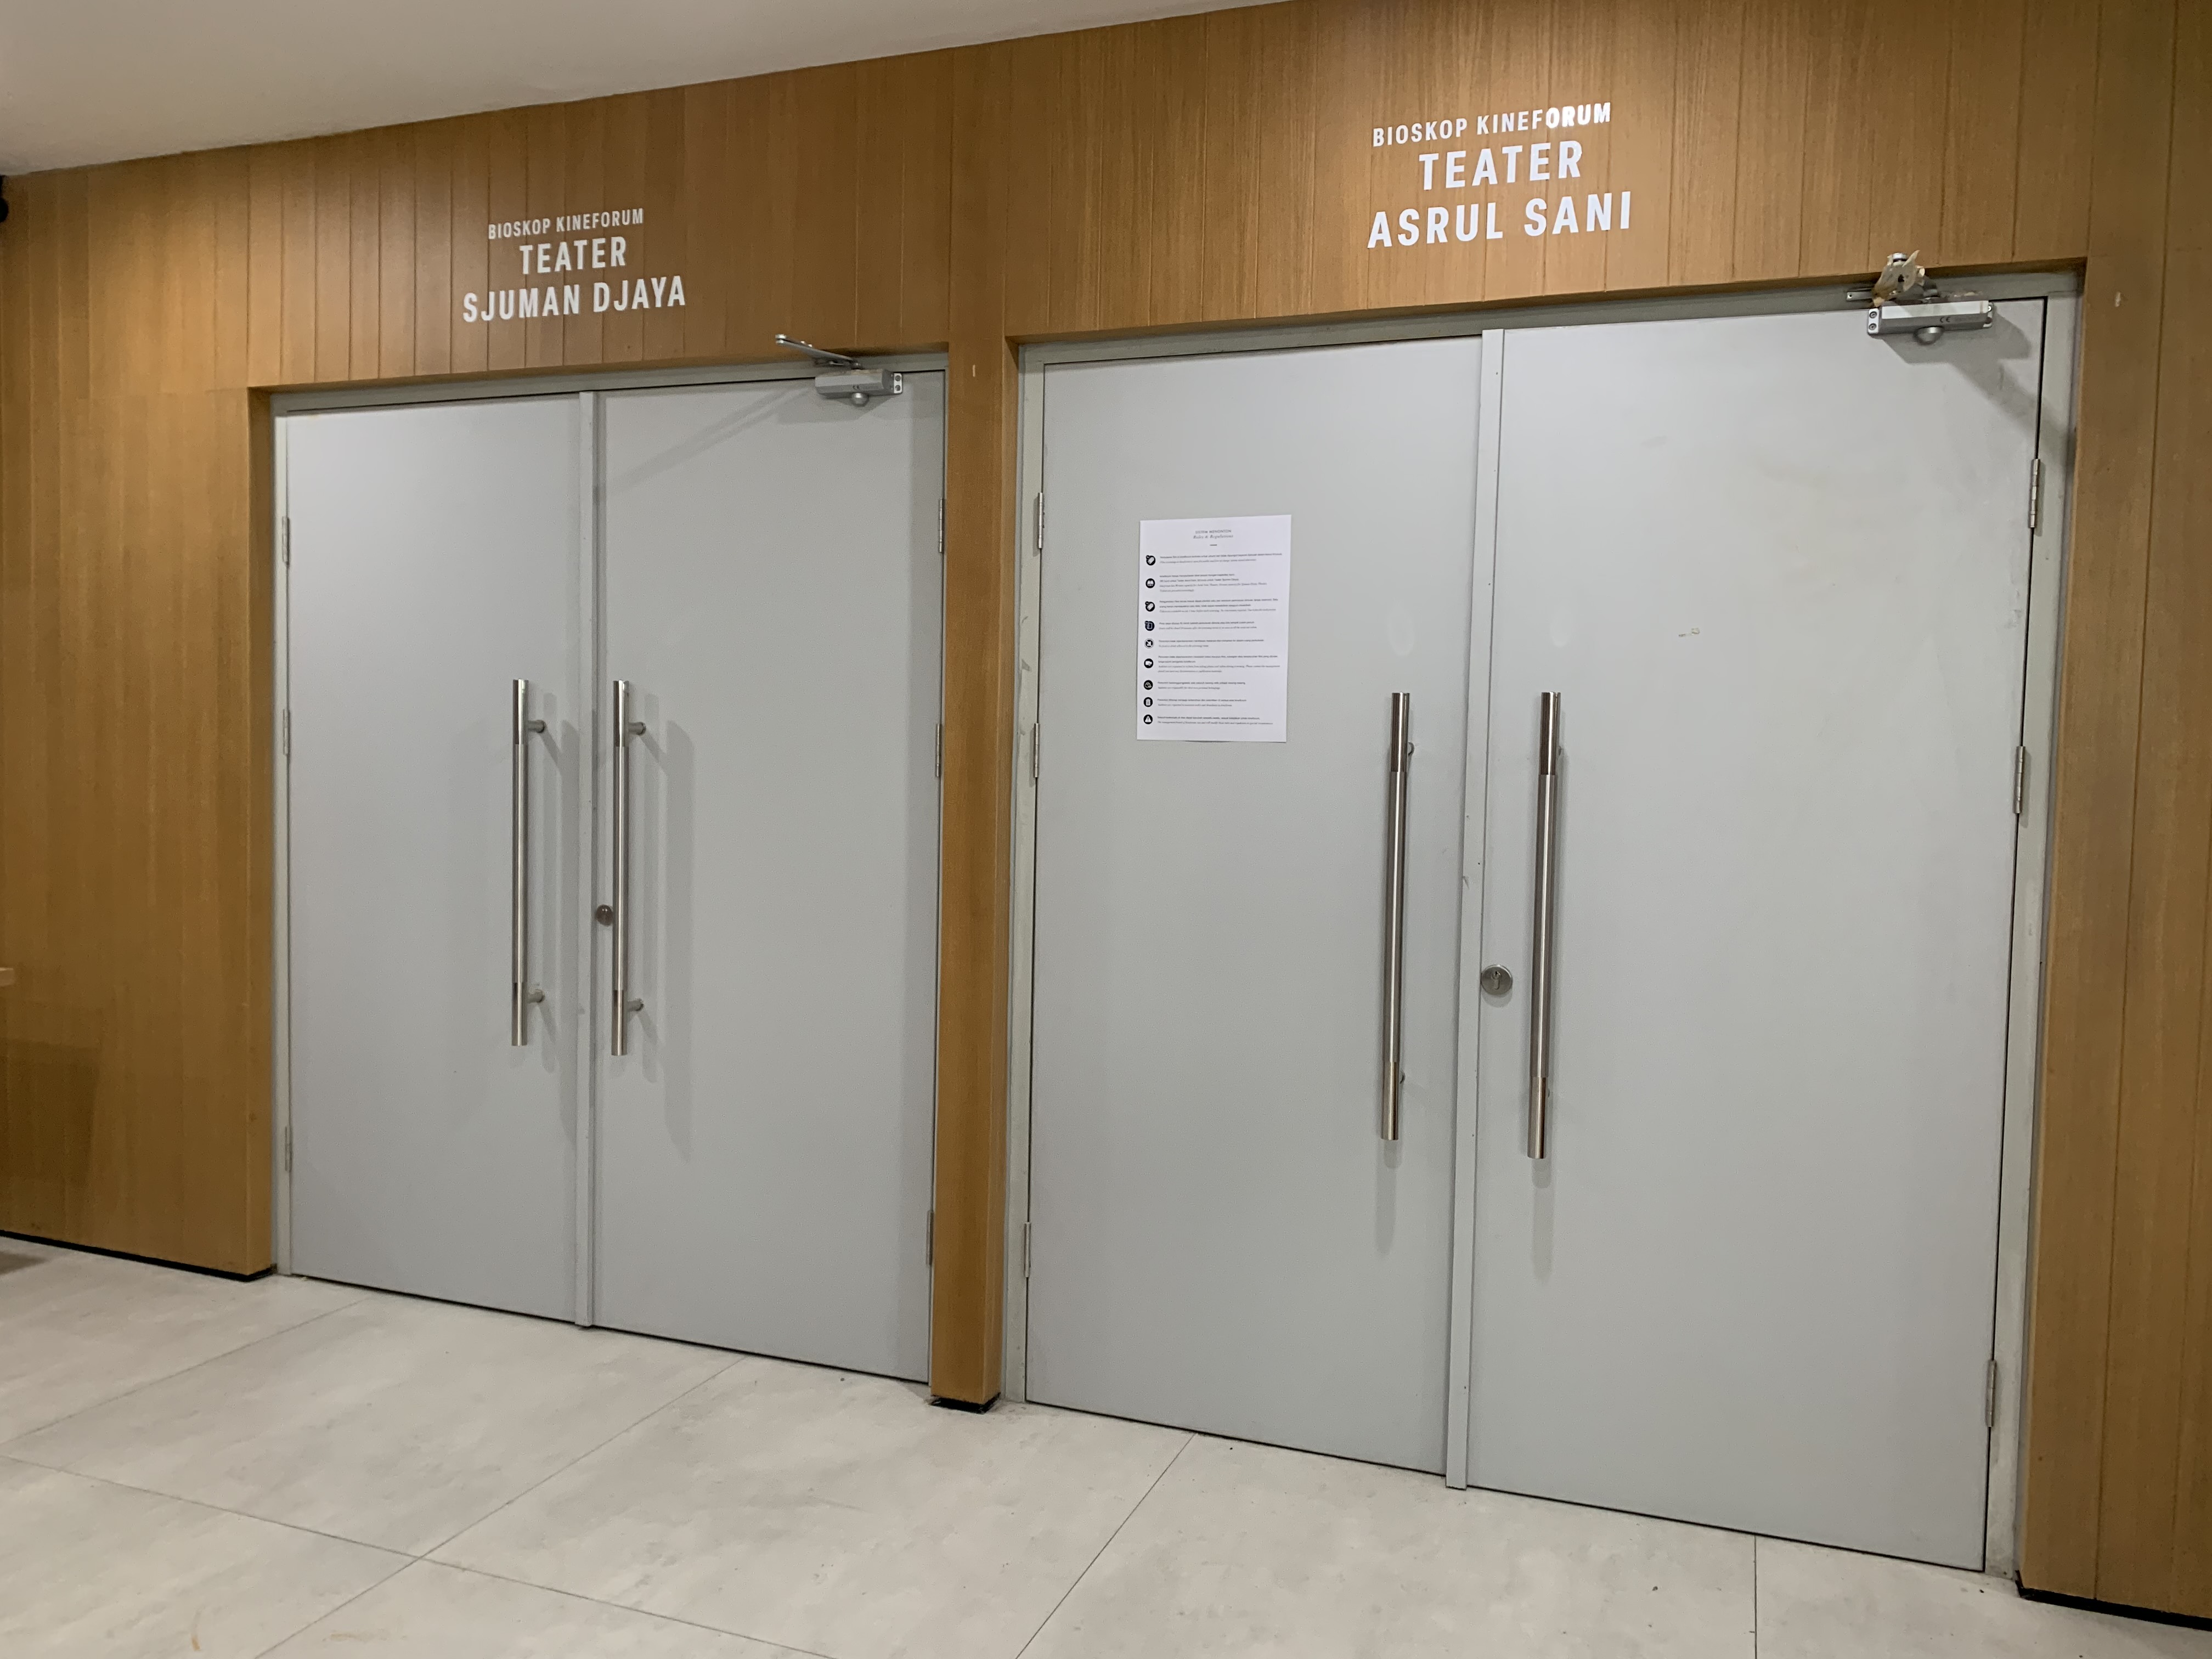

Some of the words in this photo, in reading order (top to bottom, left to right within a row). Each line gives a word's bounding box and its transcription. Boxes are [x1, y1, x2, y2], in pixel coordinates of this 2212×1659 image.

[1373, 118, 1468, 147] BIOSKOP
[1477, 102, 1611, 135] KINEFORUM
[1419, 140, 1583, 190] TEATER
[488, 218, 551, 240] BIOSKOP
[556, 208, 644, 233] KINEFORUM
[1367, 202, 1503, 249] ASRUL
[1524, 191, 1631, 236] SANI
[520, 236, 626, 274] TEATER
[462, 284, 580, 323] SJUMAN
[593, 275, 686, 313] DJAYA
